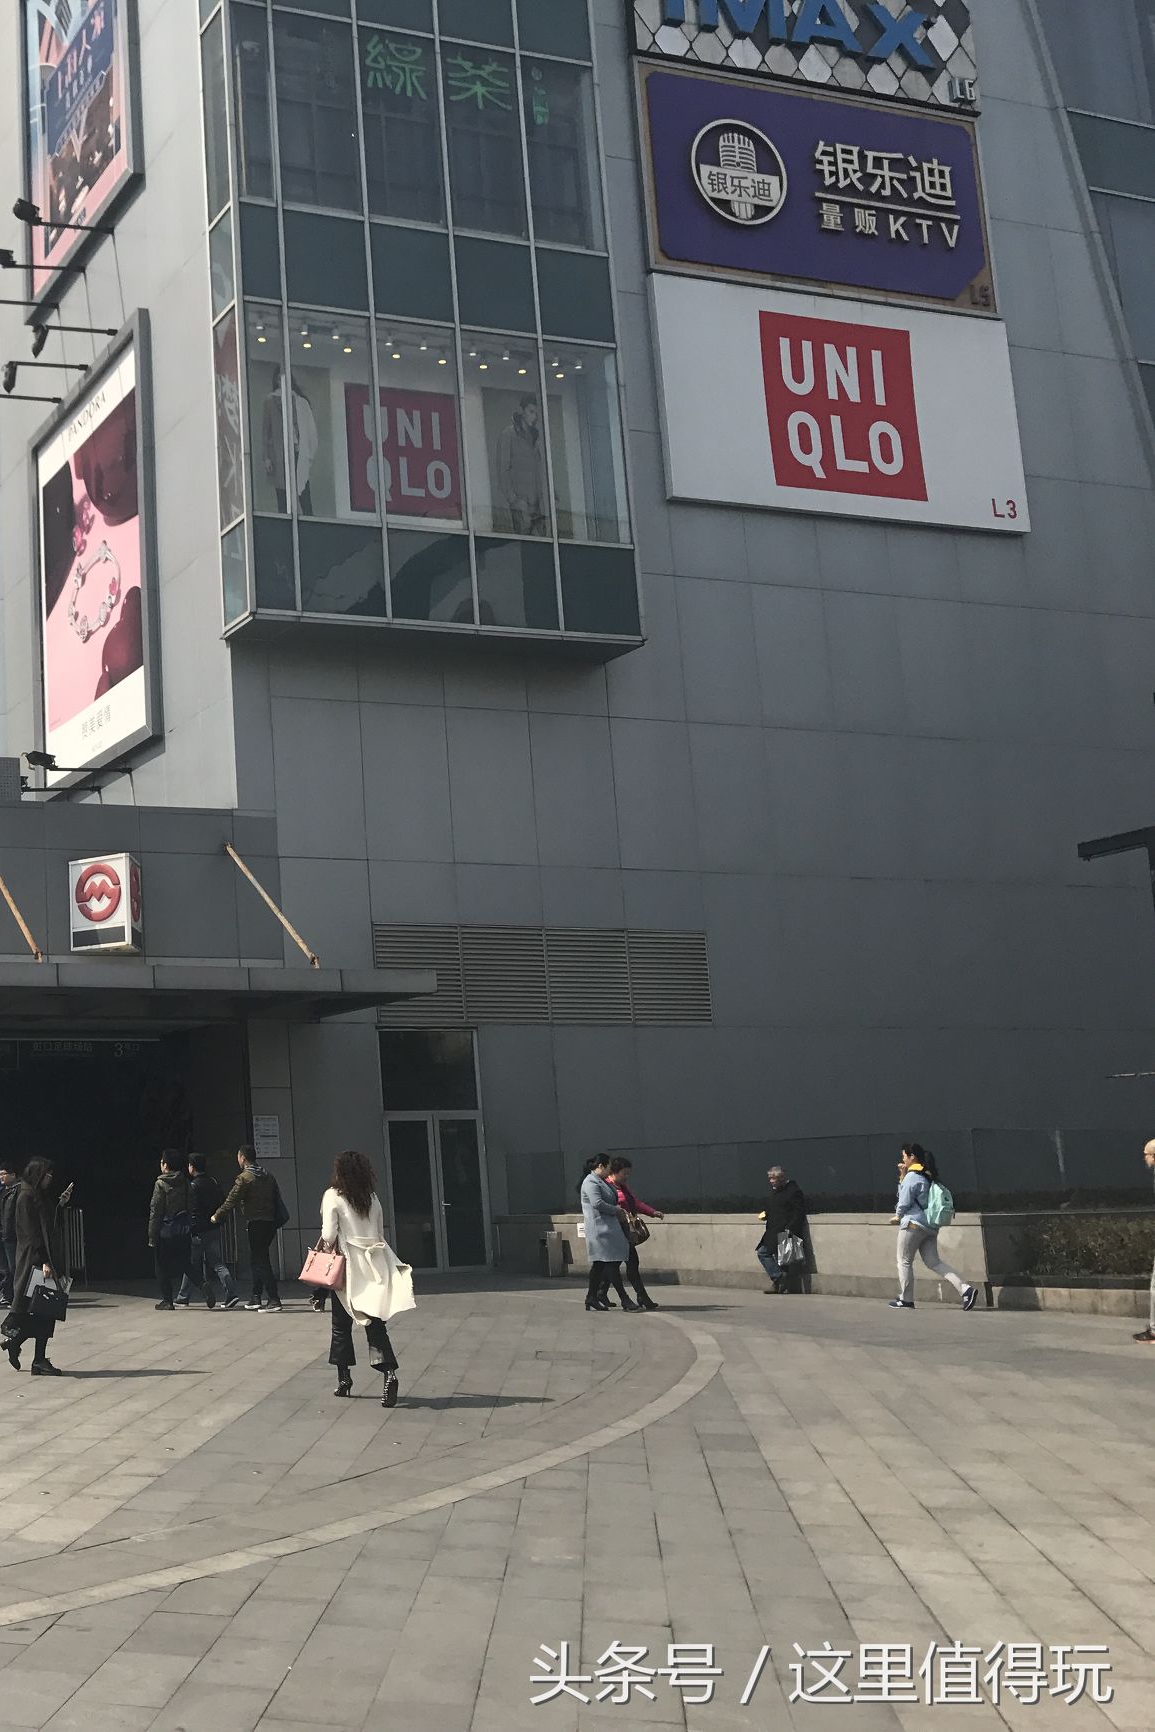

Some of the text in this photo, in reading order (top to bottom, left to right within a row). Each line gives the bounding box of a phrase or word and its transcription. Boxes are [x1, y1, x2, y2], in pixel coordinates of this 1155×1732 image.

[707, 170, 774, 203] 银乐迪
[814, 140, 957, 207] 银乐迪
[779, 336, 887, 407] UNI
[363, 404, 442, 451] UNI
[787, 410, 904, 479] QLO
[366, 455, 452, 502] QLO
[991, 498, 1018, 519] L3
